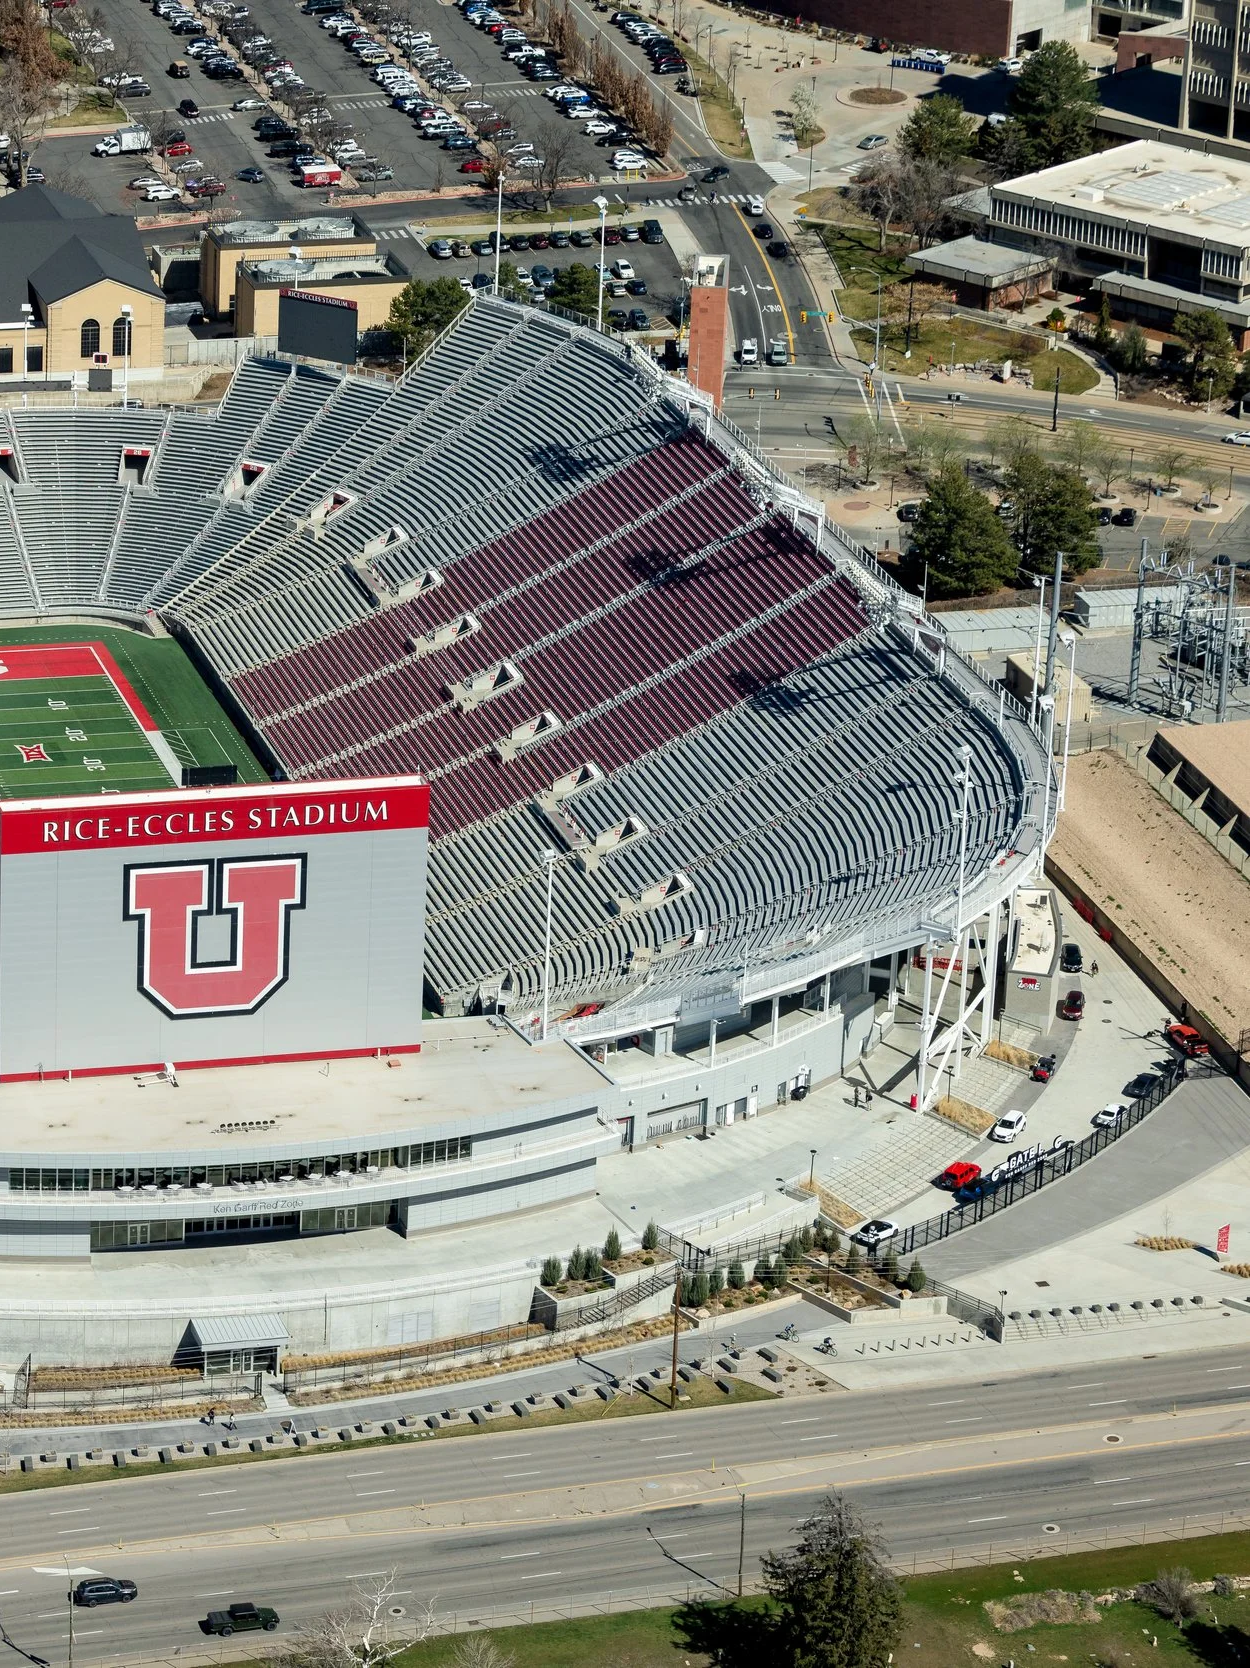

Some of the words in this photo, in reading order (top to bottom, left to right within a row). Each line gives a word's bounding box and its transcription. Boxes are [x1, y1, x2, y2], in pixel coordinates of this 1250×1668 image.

[287, 290, 321, 303] RICE-ECCLES
[321, 296, 348, 308] STADIUM
[761, 304, 782, 313] ONLY
[47, 700, 69, 711] 10
[65, 729, 88, 742] 20
[83, 758, 106, 771] 30
[43, 810, 235, 842] RICE-ECCLES
[248, 799, 390, 830] STADIUM
[122, 852, 308, 1020] U
[1017, 980, 1041, 991] ZONE
[1009, 1146, 1035, 1169] GATE
[213, 1203, 231, 1214] Ken
[234, 1202, 258, 1213] Garff
[259, 1200, 279, 1210] Red
[280, 1198, 304, 1209] Zone
